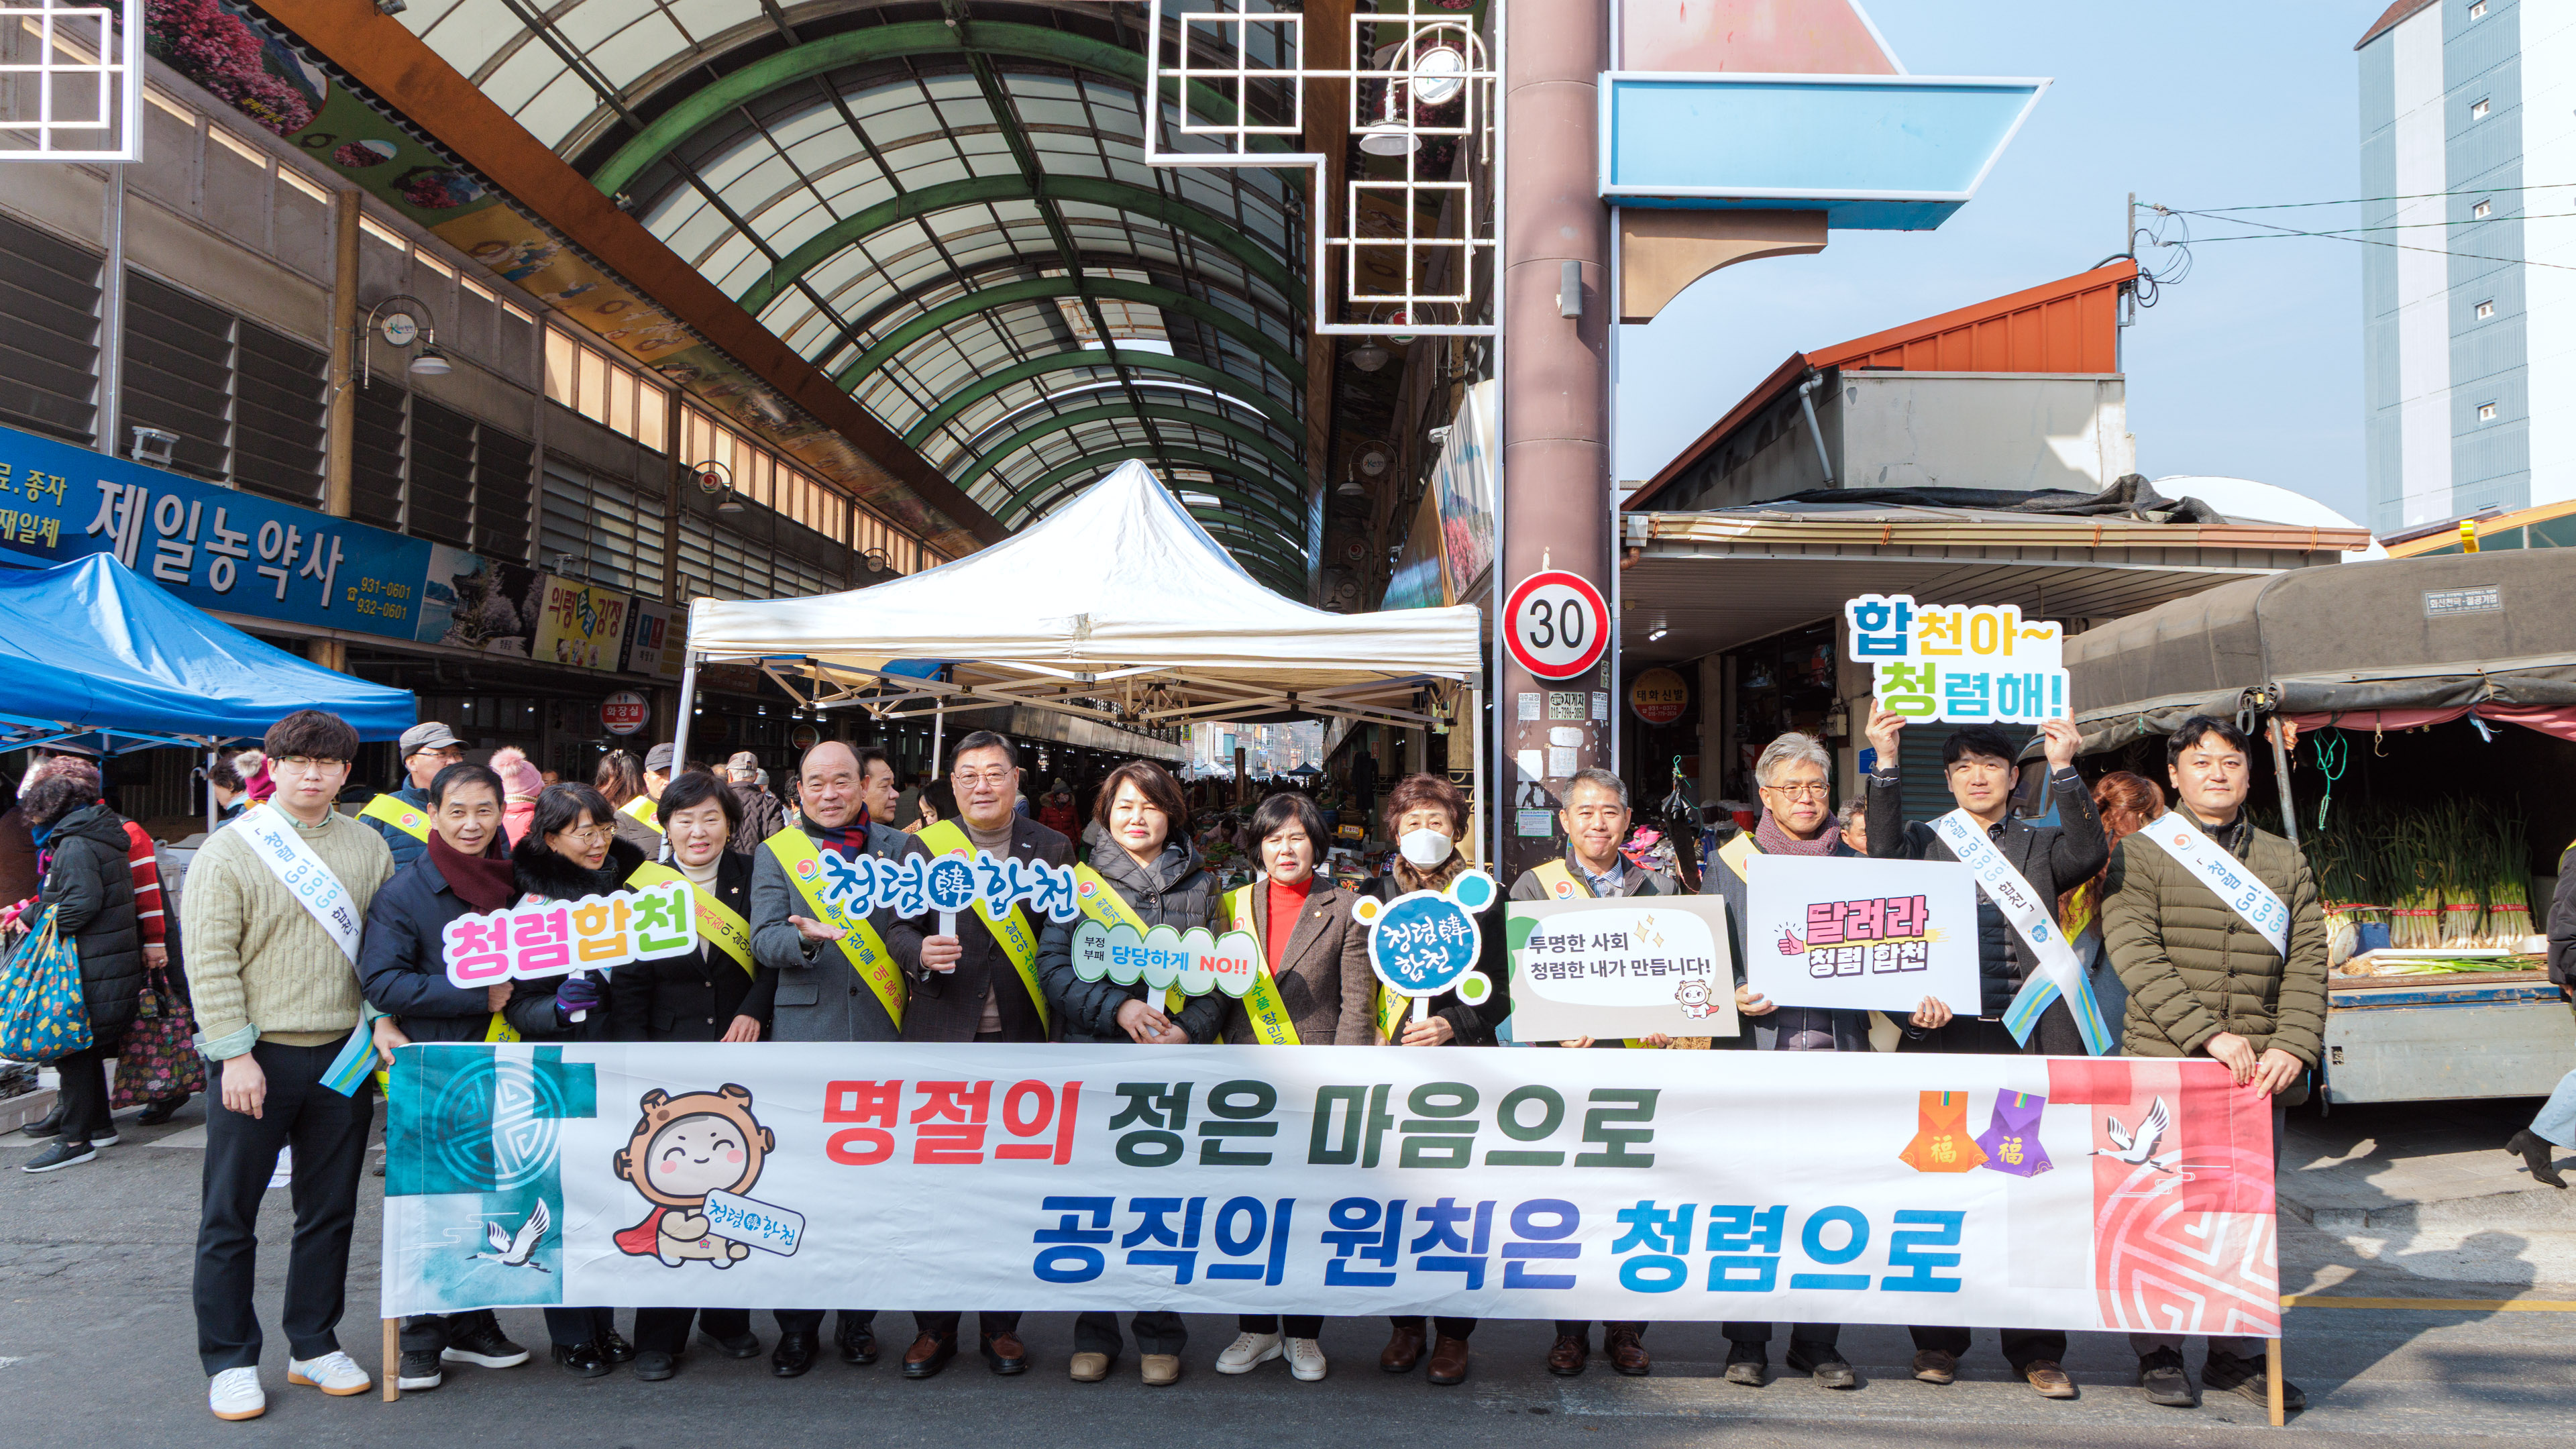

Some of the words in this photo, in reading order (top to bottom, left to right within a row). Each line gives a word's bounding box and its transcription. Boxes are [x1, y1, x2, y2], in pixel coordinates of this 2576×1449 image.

[86, 480, 344, 606] 제일농약사
[361, 577, 411, 599] 931-0601
[357, 598, 407, 619] 932-0601
[596, 598, 623, 637] 강정
[1529, 599, 1584, 649] 30
[1854, 602, 2054, 656] 합천아~
[1564, 693, 1584, 706] 지게차
[1637, 689, 1684, 702] 태화신발
[1881, 662, 2061, 717] 청렴해!
[606, 706, 639, 716] 화장실
[1957, 837, 1984, 858] Go!
[1972, 849, 1997, 870] Go!
[284, 858, 314, 884] Go!
[300, 869, 329, 896] Go!
[315, 882, 343, 909] Go!
[1984, 860, 2010, 881] Go!
[694, 900, 734, 936] 통시장이
[2235, 885, 2262, 912] Go!
[2252, 896, 2277, 922] Go!
[451, 889, 690, 980] 청렴합천
[1806, 894, 1929, 946] 달려라
[1083, 949, 1104, 961] 부패
[1084, 936, 1105, 948] 부정
[1529, 934, 1585, 955] 투명한
[1591, 932, 1629, 951] 사회
[1112, 946, 1189, 971] 당당하게
[1199, 955, 1248, 975] NO!!
[1395, 946, 1454, 982] 합천
[1531, 960, 1585, 981] 청렴한
[1590, 959, 1626, 978] 내가
[1631, 957, 1711, 977] 만듭니다!
[1809, 945, 1865, 979] 청렴
[1872, 940, 1929, 974] 합천
[873, 965, 904, 1016] 애용합
[822, 1079, 1084, 1166] 명절의
[1108, 1079, 1279, 1168] 정은
[1307, 1081, 1663, 1169] 마음으로
[1930, 1134, 1957, 1163] 福
[1997, 1136, 2024, 1165] 福
[1032, 1195, 1297, 1287] 공직의
[1319, 1197, 1582, 1291] 원칙은
[1611, 1199, 1968, 1294] 청렴으로
